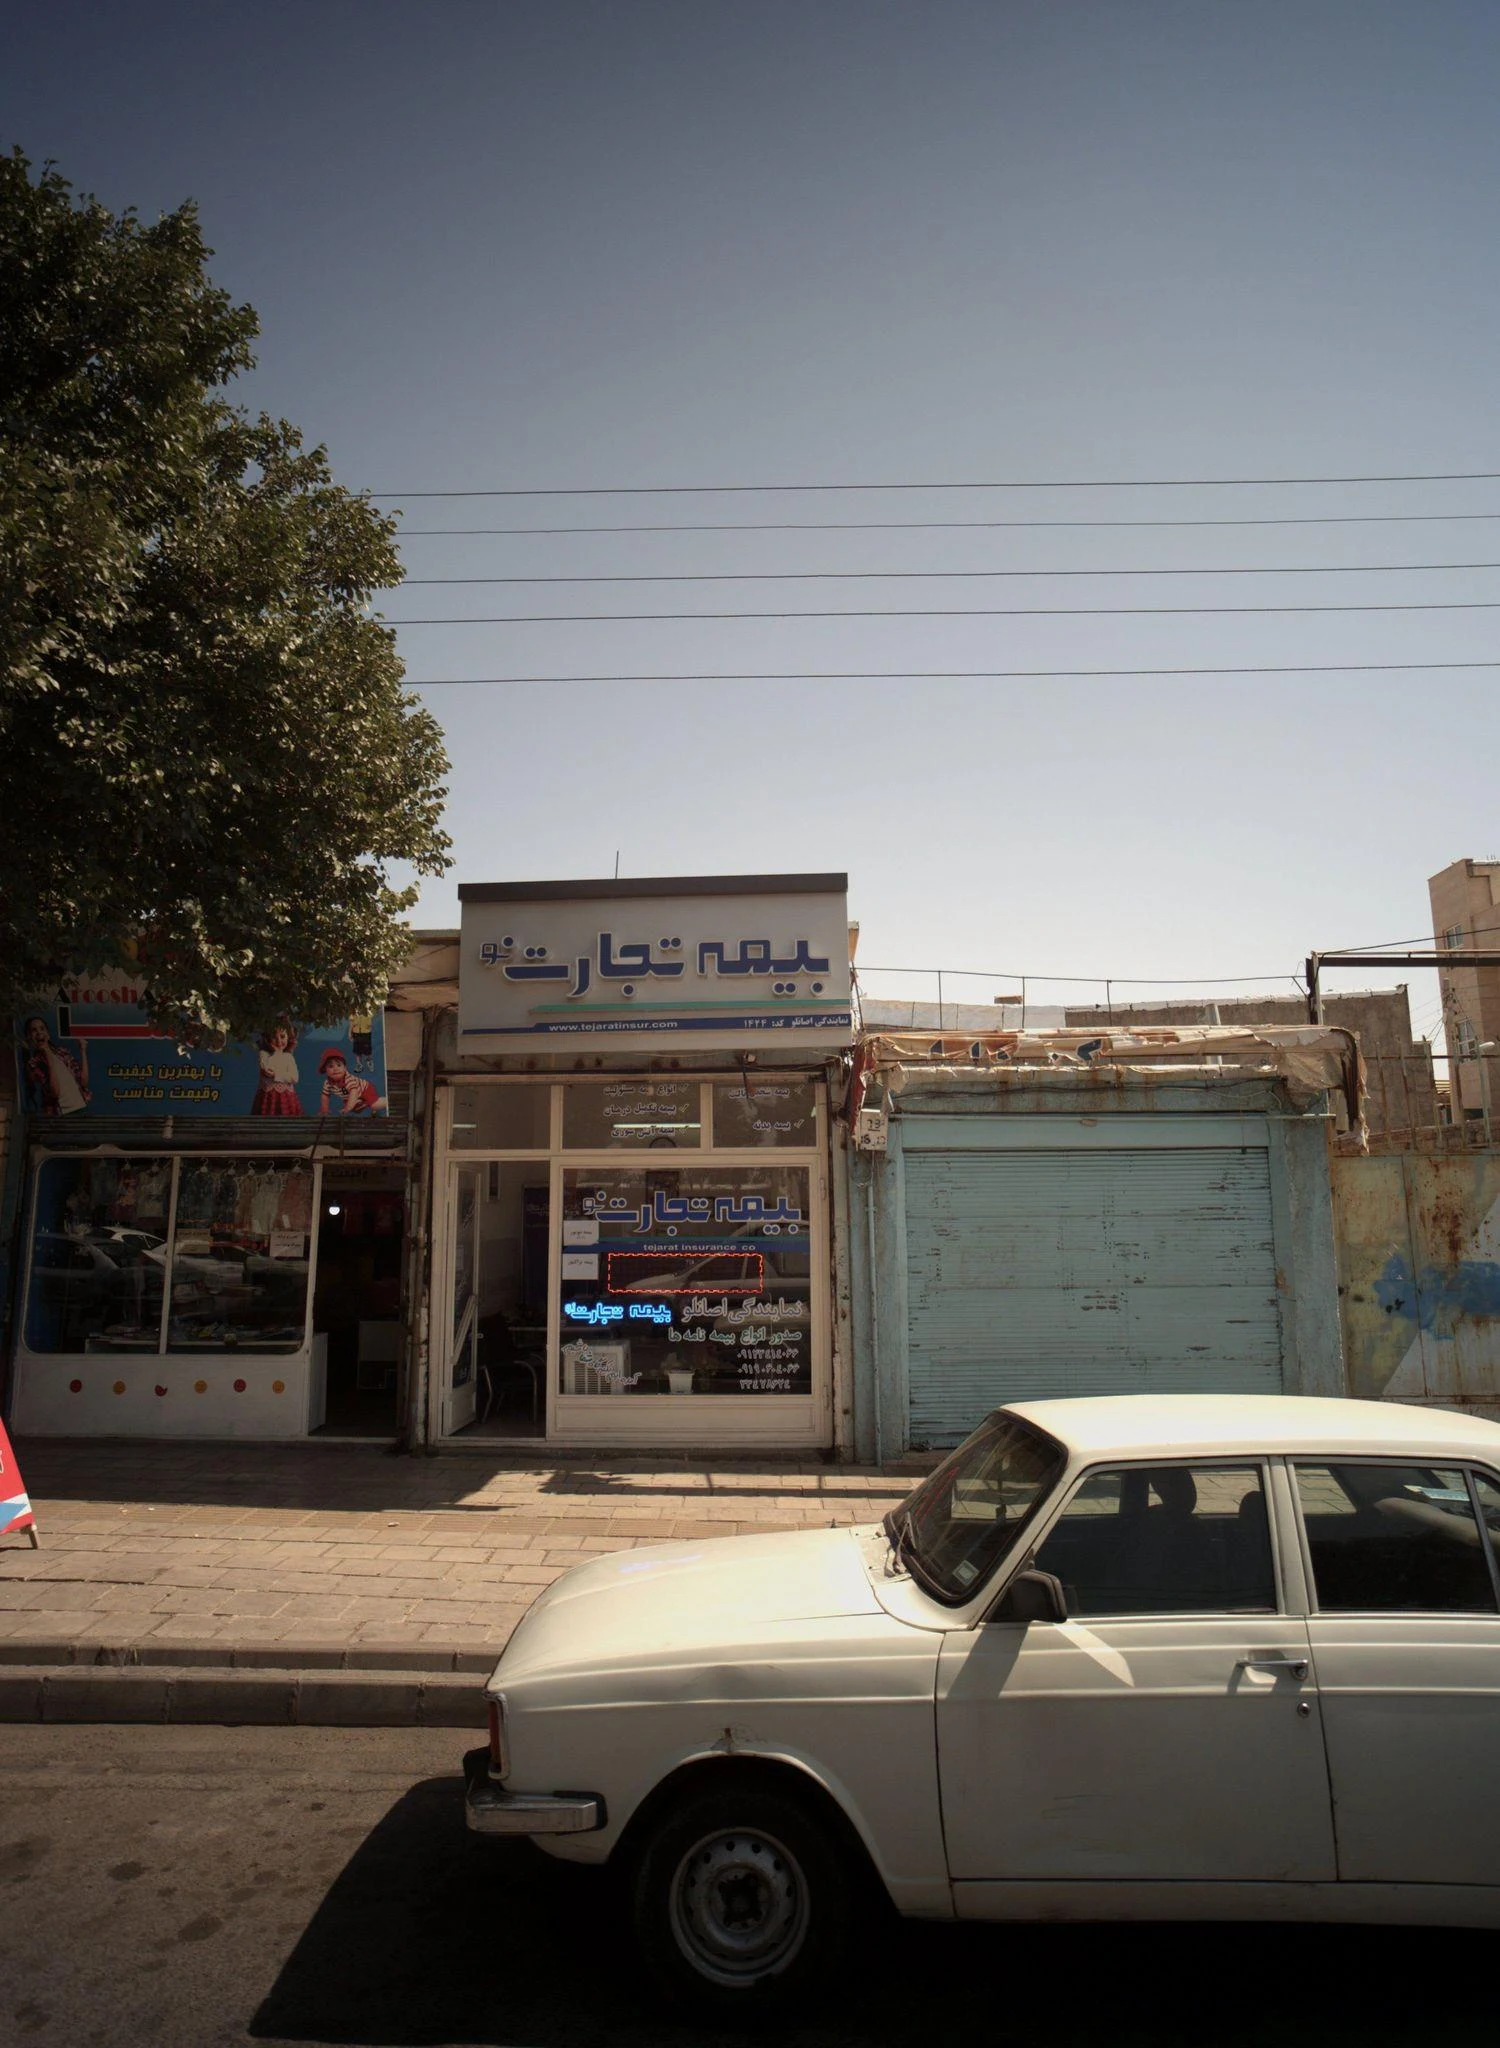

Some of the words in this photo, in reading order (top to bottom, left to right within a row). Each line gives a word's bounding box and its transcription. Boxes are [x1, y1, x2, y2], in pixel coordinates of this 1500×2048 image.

[479, 934, 515, 968] نو
[502, 931, 685, 997] تجارت
[697, 938, 831, 997] بیمه
[548, 1020, 678, 1032] www.tejaratinsur.com
[814, 1016, 849, 1027] نمایندگی
[107, 1064, 153, 1079] کیفیت
[157, 1064, 205, 1081] بهترین
[209, 1064, 223, 1078] با
[112, 1086, 164, 1102] مناسب
[773, 1088, 791, 1098] بیمه
[603, 1104, 632, 1117] درمان
[658, 1104, 677, 1115] بیمه
[773, 1121, 791, 1132] بیمه
[583, 1190, 606, 1215] نو
[594, 1190, 712, 1236] تجارت
[715, 1196, 802, 1235] بیمه
[643, 1243, 678, 1253] tejarat
[681, 1243, 737, 1252] insurance
[741, 1244, 756, 1252] co
[570, 1302, 624, 1325] تجارت
[629, 1303, 672, 1324] بیمه
[681, 1296, 728, 1323] اصانلو
[727, 1296, 803, 1324] نمایندگی
[668, 1326, 682, 1342] ها
[683, 1326, 706, 1342] نامه
[709, 1329, 736, 1345] بیمه
[740, 1325, 767, 1345] انواع
[769, 1329, 802, 1345] صدور
